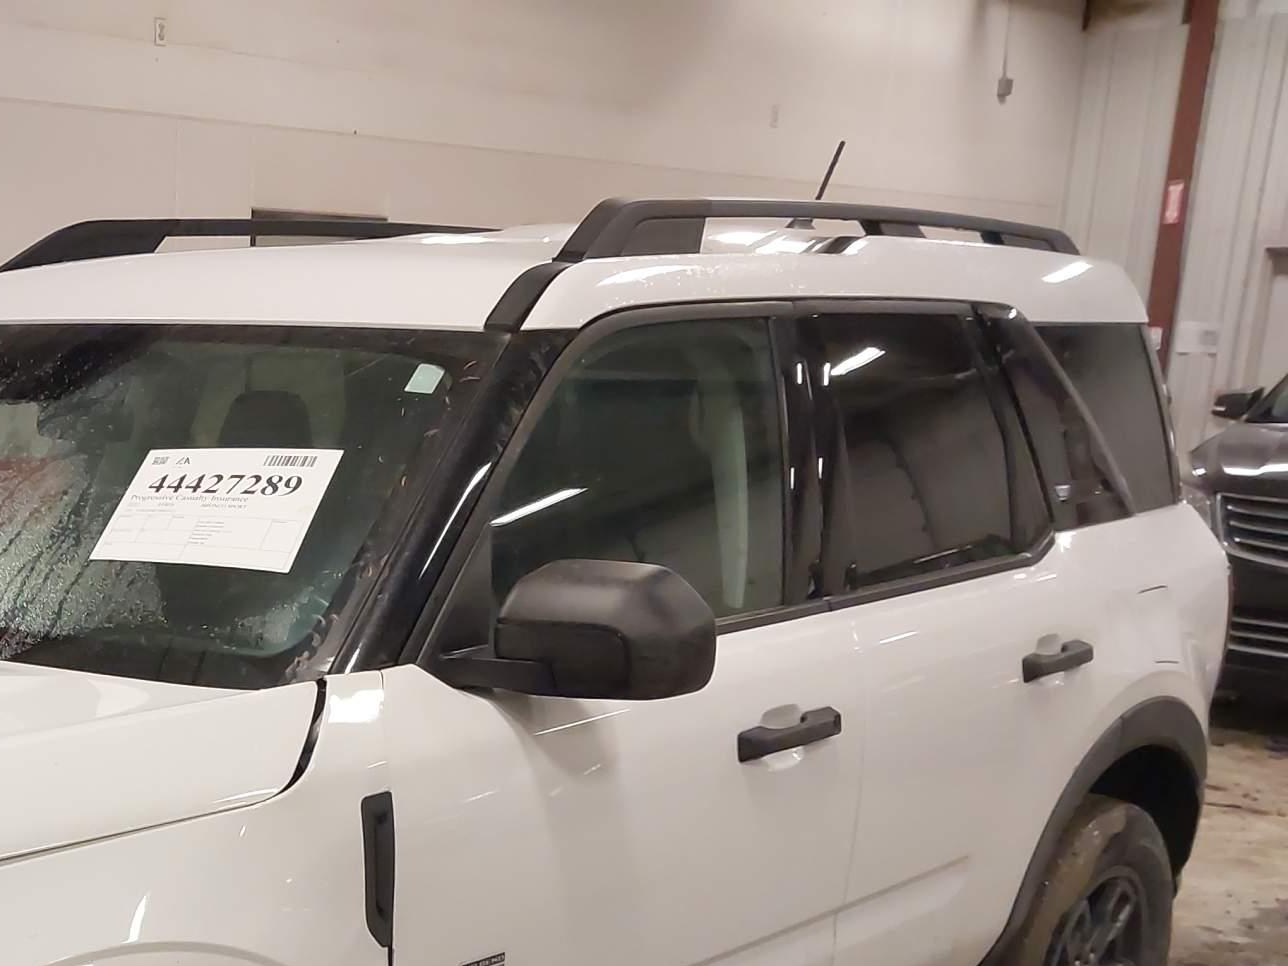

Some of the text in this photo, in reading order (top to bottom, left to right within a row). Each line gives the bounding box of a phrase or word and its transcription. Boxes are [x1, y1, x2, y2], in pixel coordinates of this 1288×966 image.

[148, 473, 303, 497] 44427289
[130, 494, 174, 502] Progressive
[211, 495, 249, 503] Insurance
